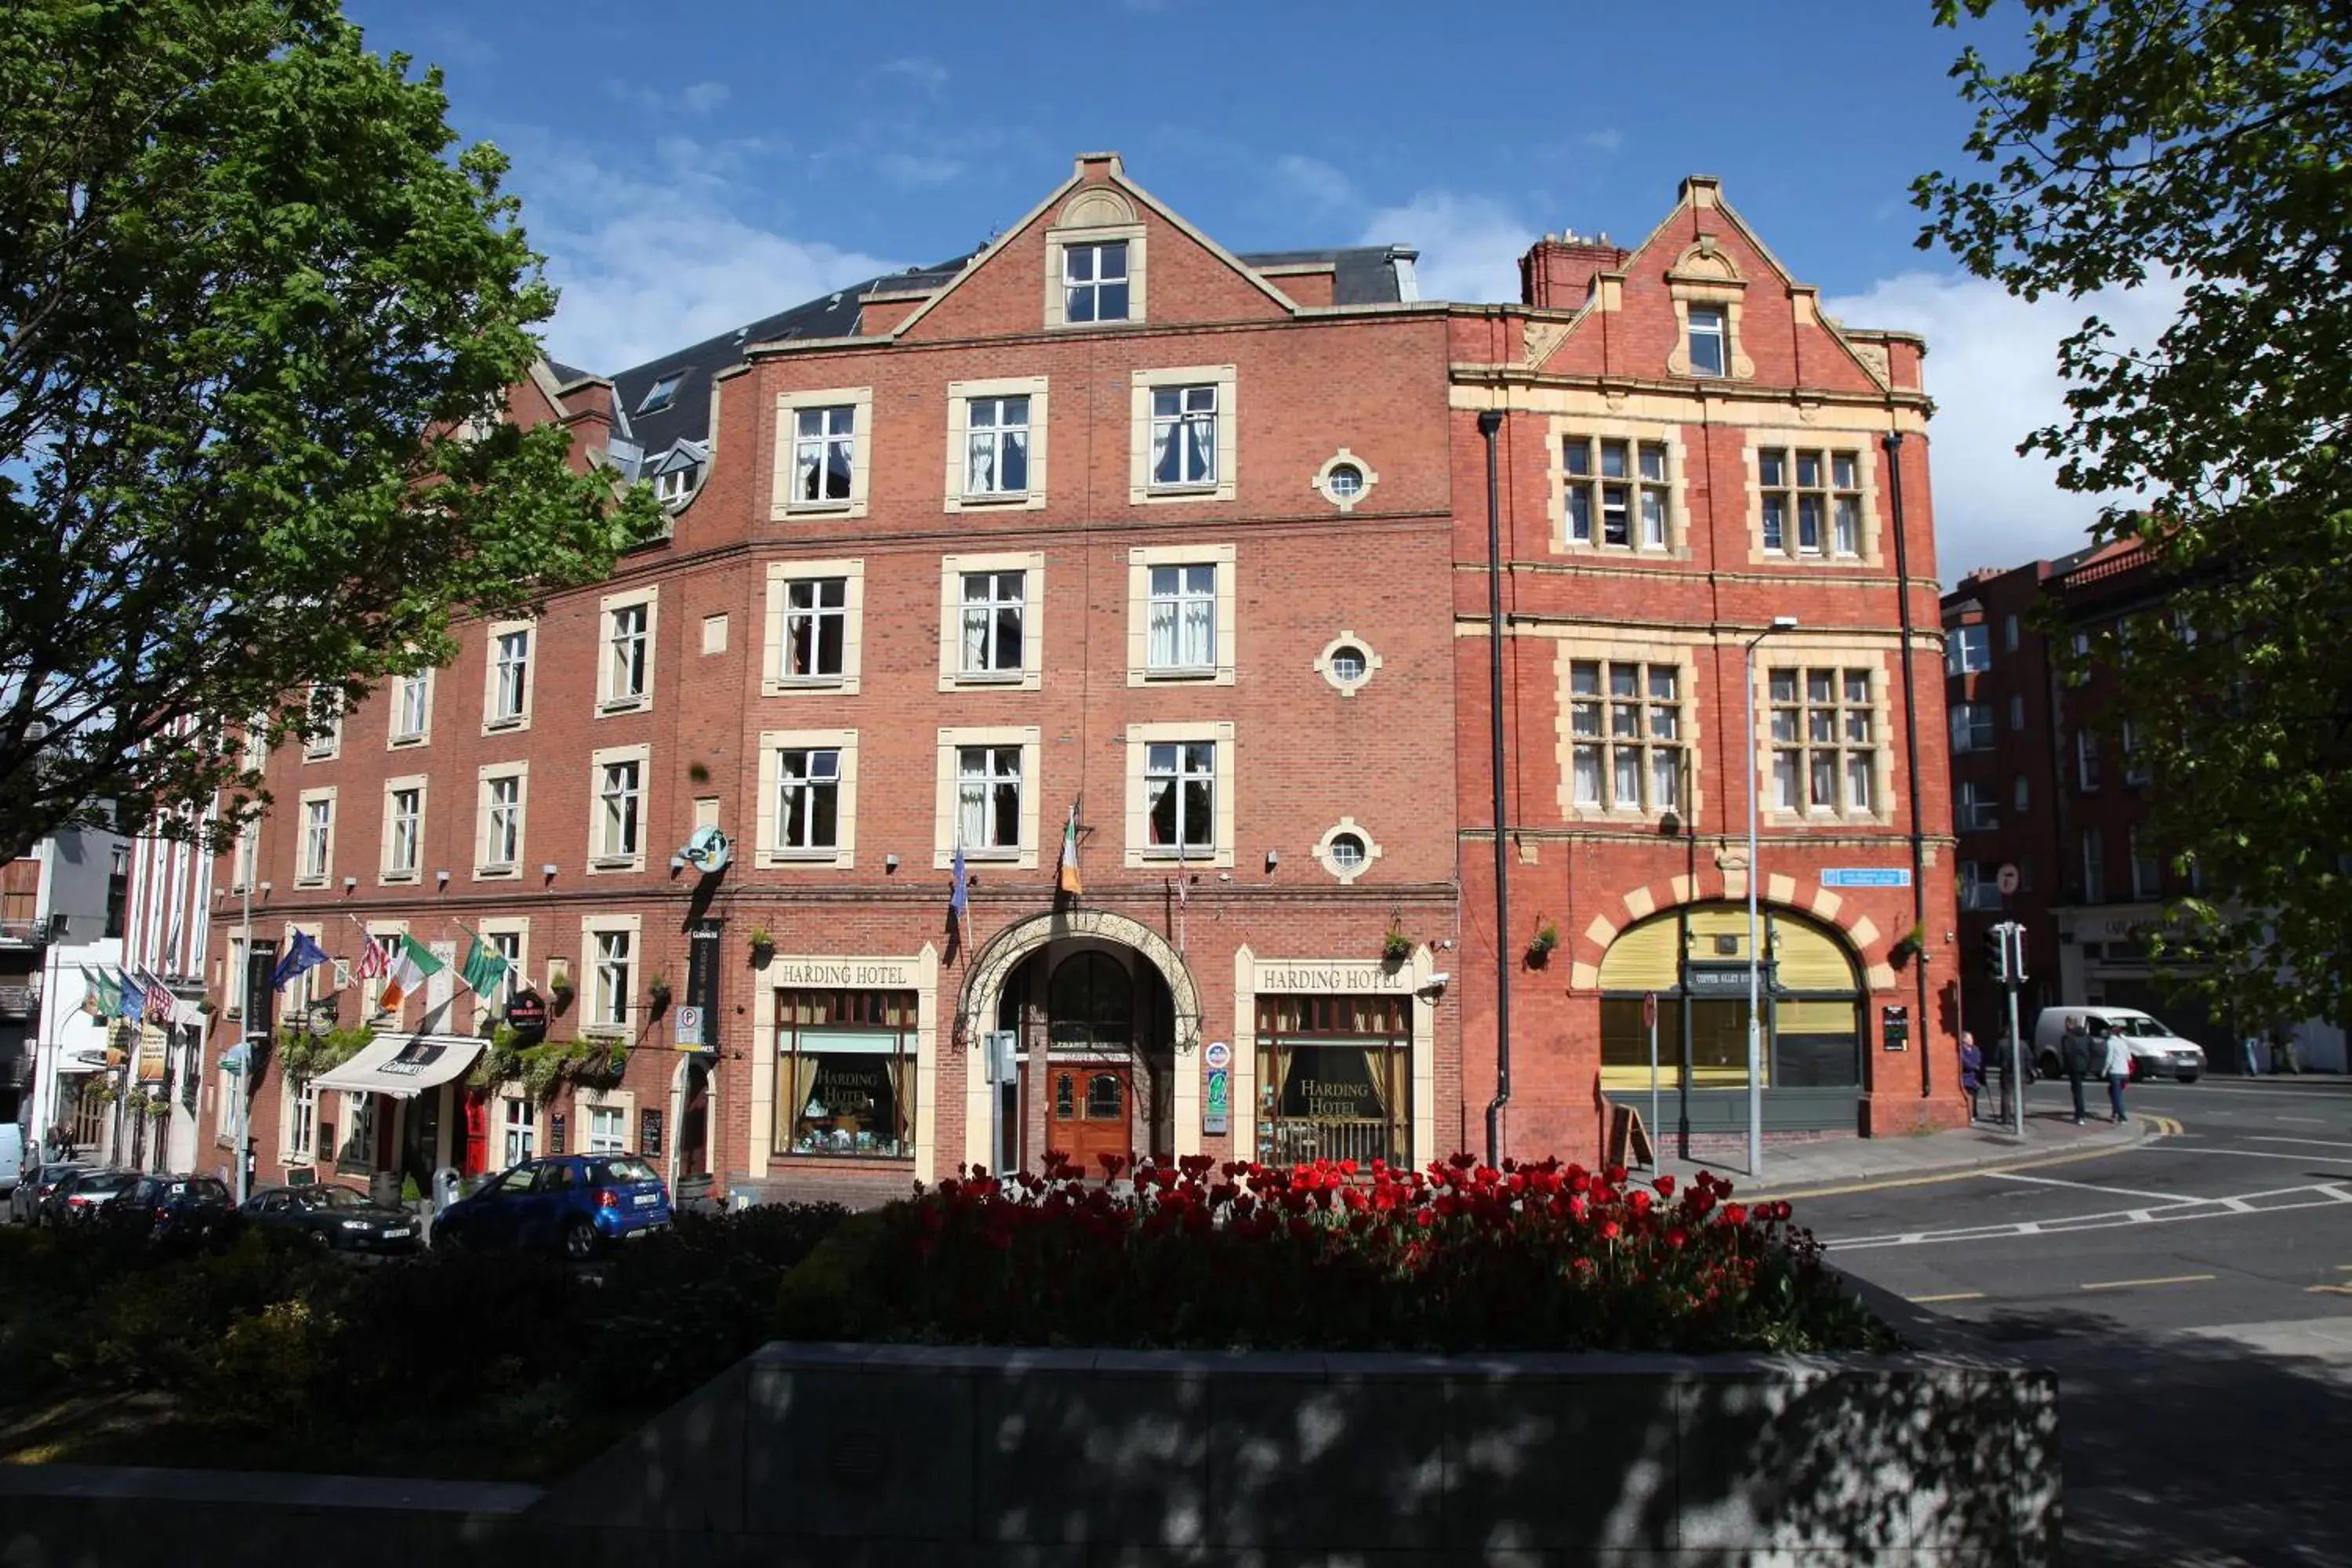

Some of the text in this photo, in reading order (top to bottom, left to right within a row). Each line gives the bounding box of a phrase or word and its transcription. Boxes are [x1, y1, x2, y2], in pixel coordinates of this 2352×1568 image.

[784, 965, 907, 984] HARDING HOTEL
[1264, 970, 1403, 989] HARDING HOTEL
[817, 1069, 878, 1087] HARDING
[1301, 1079, 1369, 1098] HARDING
